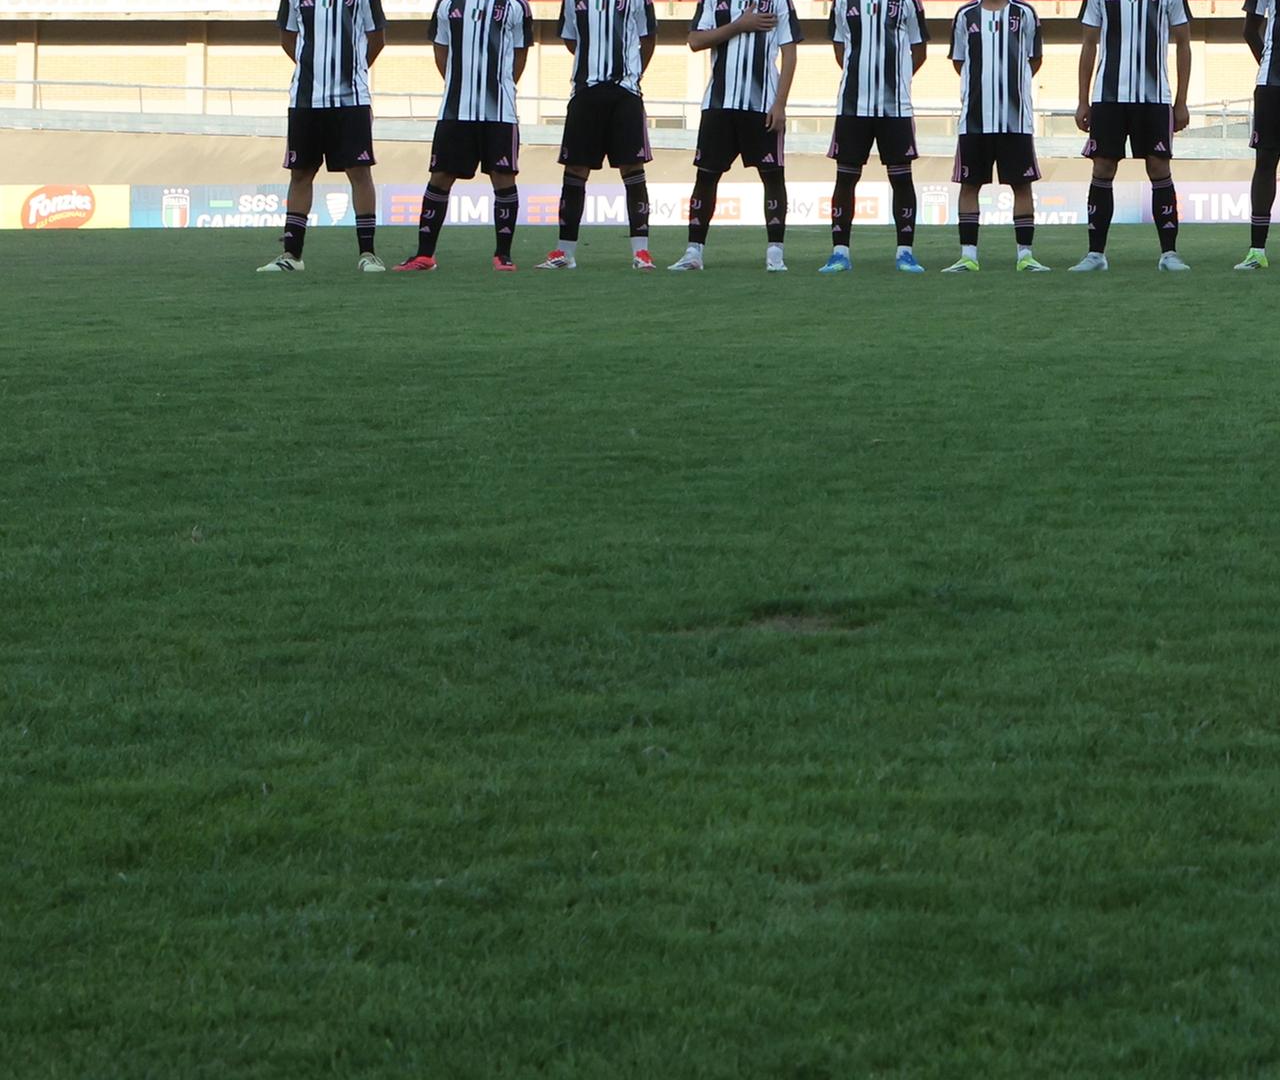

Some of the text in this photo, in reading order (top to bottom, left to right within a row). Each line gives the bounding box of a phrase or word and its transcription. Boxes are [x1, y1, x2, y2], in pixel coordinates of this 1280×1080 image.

[28, 190, 92, 224] Fonzies
[238, 194, 279, 212] SGS
[450, 196, 489, 222] IM
[586, 196, 625, 222] IM
[1188, 193, 1251, 220] TIM
